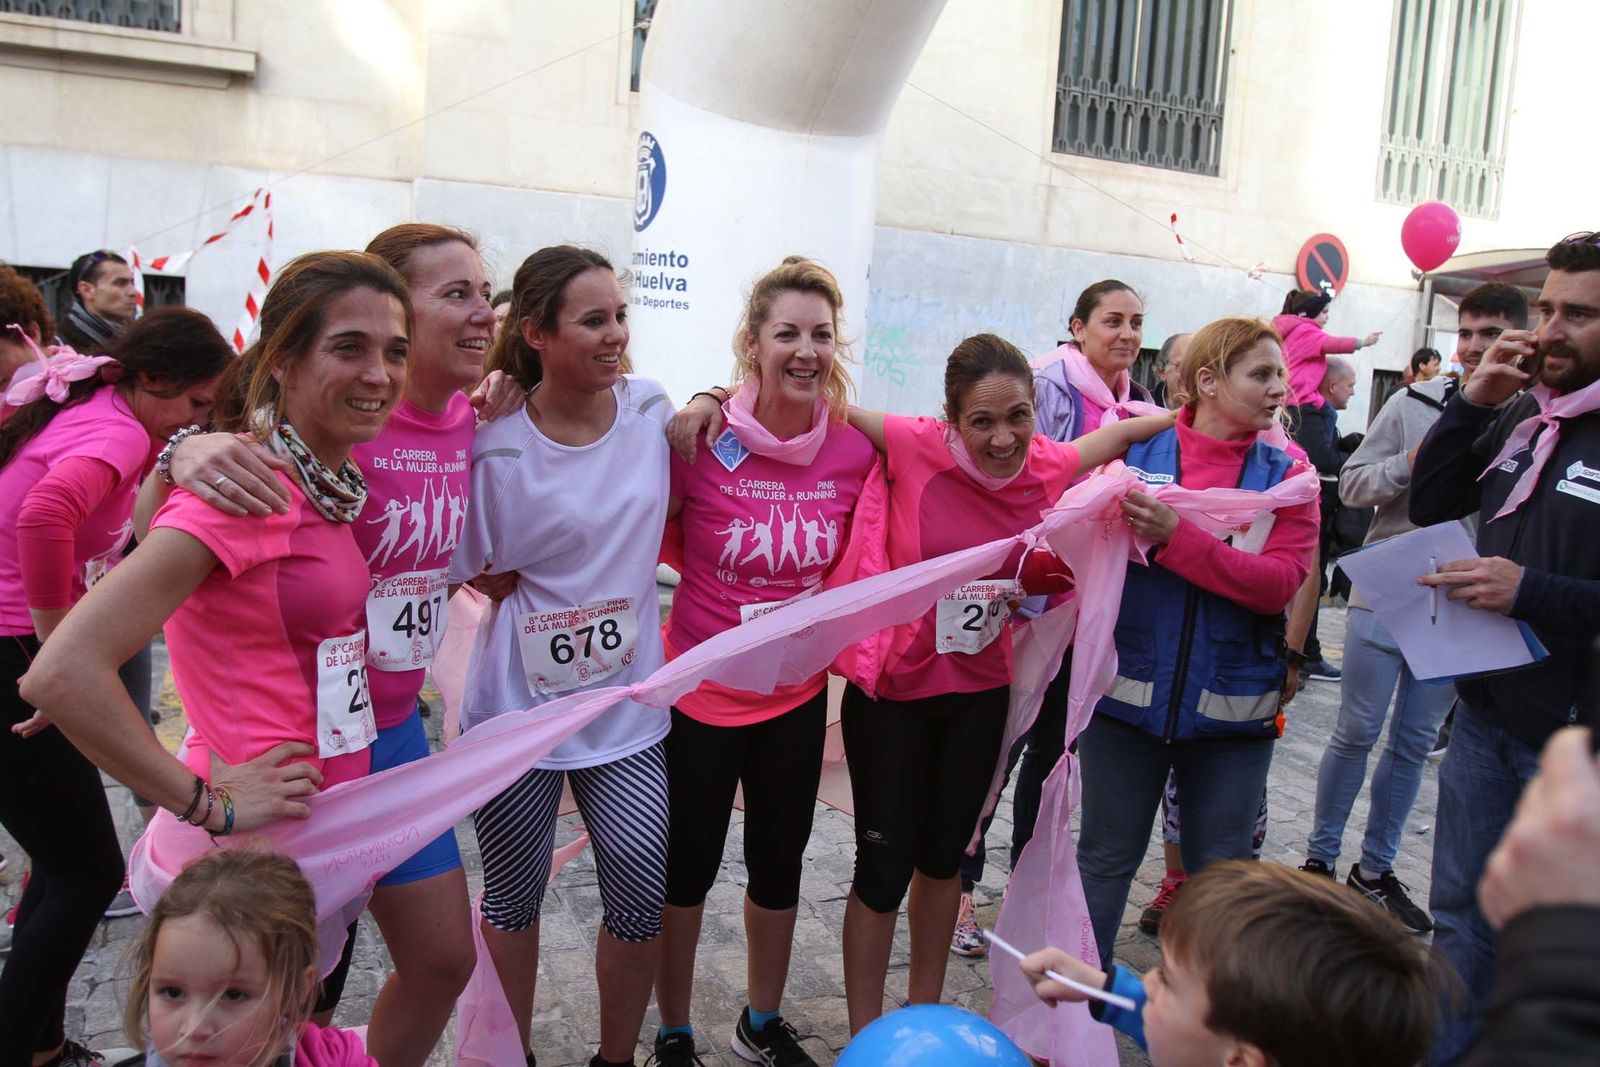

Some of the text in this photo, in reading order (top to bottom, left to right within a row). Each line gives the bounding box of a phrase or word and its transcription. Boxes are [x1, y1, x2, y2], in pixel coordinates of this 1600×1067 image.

[634, 270, 687, 292] Huelva
[643, 295, 689, 310] Deportes
[393, 448, 437, 461] CARRERA
[374, 457, 388, 469] DE
[391, 460, 403, 471] LA
[406, 461, 438, 472] MUJER
[739, 479, 836, 490] CARRERA PINK
[720, 485, 734, 496] DE
[736, 487, 749, 498] LA
[751, 490, 786, 501] MUJER
[796, 489, 837, 501] RUNNING
[391, 577, 427, 588] CARRERA
[960, 585, 996, 593] CARRERA
[374, 589, 386, 599] DE
[387, 588, 398, 598] LA
[400, 586, 428, 597] MUJER
[957, 592, 968, 601] LA
[969, 592, 996, 601] MUJER
[392, 595, 441, 638] 497
[528, 598, 628, 625] 8ª CARRERA PINK
[524, 625, 537, 635] DE
[538, 622, 550, 632] LA
[551, 617, 580, 630] MUJER
[588, 604, 629, 619] RUNNING
[550, 618, 622, 665] 678
[325, 655, 339, 668] DE
[340, 651, 352, 666] LA
